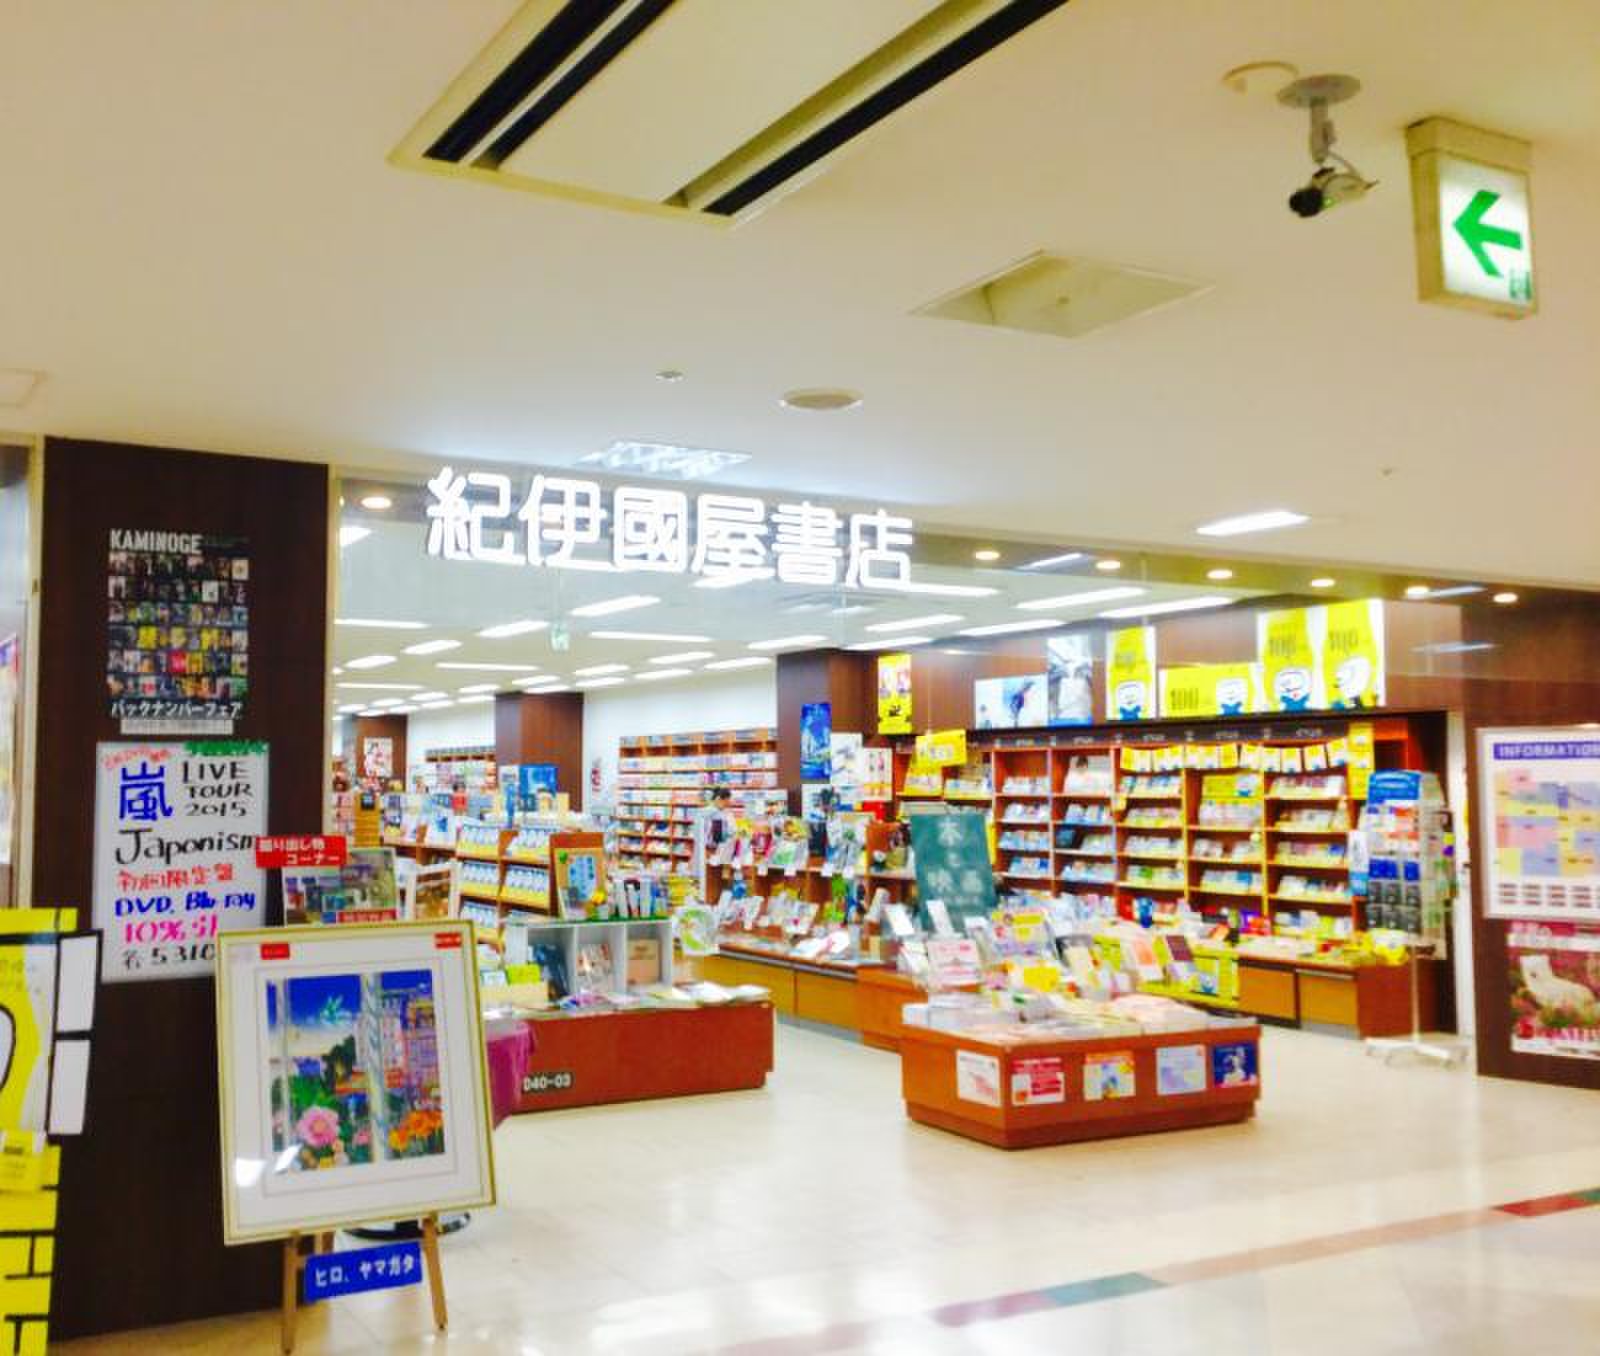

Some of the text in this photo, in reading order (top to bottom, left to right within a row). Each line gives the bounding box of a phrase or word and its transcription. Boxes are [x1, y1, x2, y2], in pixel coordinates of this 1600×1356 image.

[427, 467, 913, 590] 紀伊國屋書店
[110, 530, 203, 553] KAMINOGE
[111, 702, 243, 720] バックナンバーフェア
[183, 761, 250, 783] LIVE
[119, 761, 174, 822] 嵐
[186, 783, 253, 799] TOUR
[187, 802, 247, 817] 2015
[287, 852, 341, 864] コーナー
